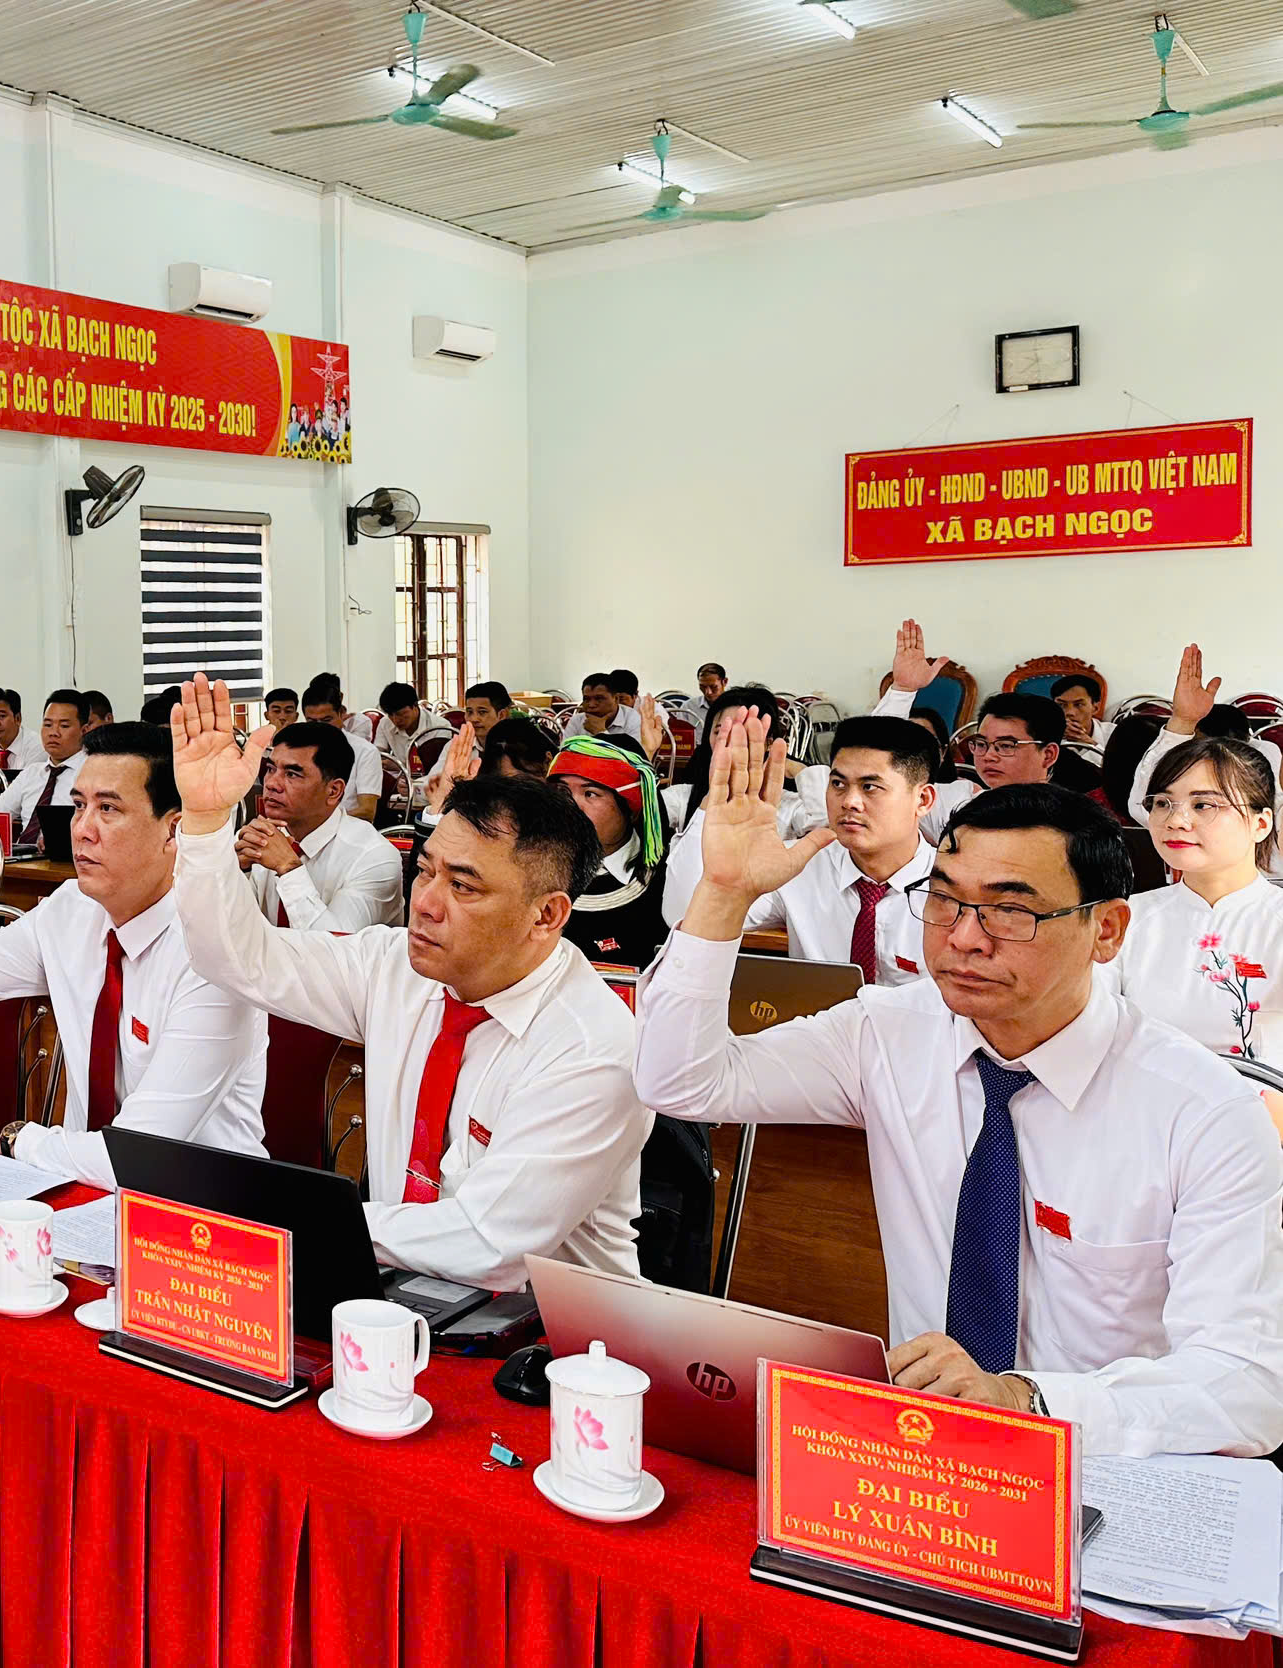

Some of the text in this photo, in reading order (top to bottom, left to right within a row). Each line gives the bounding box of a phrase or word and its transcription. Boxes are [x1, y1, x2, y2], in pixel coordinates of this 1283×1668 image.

[0, 296, 33, 352] TỘC
[38, 305, 63, 350] XÃ
[67, 315, 110, 362] BẠCH
[115, 324, 157, 371] NGỌC
[12, 366, 48, 413] CÁC
[53, 368, 86, 417] CẤP
[91, 380, 143, 431] NHIỆM
[147, 385, 166, 427] KỲ
[170, 395, 205, 431] 2025
[218, 401, 257, 437] 2030!
[857, 470, 899, 510] ĐẢNG
[904, 467, 924, 507] ỦY
[940, 472, 985, 505] HĐND
[1001, 466, 1049, 500] UBND
[1065, 463, 1090, 496] UB
[1094, 460, 1142, 494] MTTQ
[1148, 451, 1188, 495] VIỆT
[1192, 452, 1238, 487] NAM
[926, 508, 1153, 544] XÃ BẠCH NGỌC
[752, 1000, 776, 1023] hp
[134, 1237, 148, 1249] HỘI
[148, 1239, 171, 1255] ĐỒNG
[171, 1247, 194, 1261] NHÂN
[194, 1252, 211, 1266] DÂN
[224, 1261, 248, 1277] BẠCH
[248, 1268, 273, 1284] NGỌC
[141, 1250, 164, 1264] KHÓA
[185, 1261, 212, 1278] NHIỆM
[212, 1267, 225, 1281] KỲ
[135, 1287, 273, 1343] TRẦN NHẬT NGUYÊN
[170, 1276, 232, 1307] ĐẠI BIỂU
[692, 1362, 734, 1400] hp
[791, 1424, 1045, 1492] HỘI ĐỒNG NHÂN DÂN XÃ BẠCH NGỌC
[806, 1440, 845, 1460] KHÓA
[887, 1460, 934, 1481] NHIỆM
[936, 1468, 958, 1486] KỲ
[960, 1477, 988, 1493] 2026
[999, 1486, 1027, 1502] 2031
[857, 1478, 970, 1519] ĐẠI BIỂU
[784, 1512, 801, 1529] ỦY
[803, 1518, 831, 1538] VIÊN
[832, 1528, 856, 1545] BTV
[858, 1534, 892, 1554] ĐẢNG
[893, 1540, 911, 1558] ỦY
[919, 1549, 946, 1568] CHỦ
[947, 1556, 978, 1577] TỊCH
[980, 1564, 1052, 1594] UBMTTQVN
[833, 1500, 998, 1557] LÝ XUÂN BÌNH
